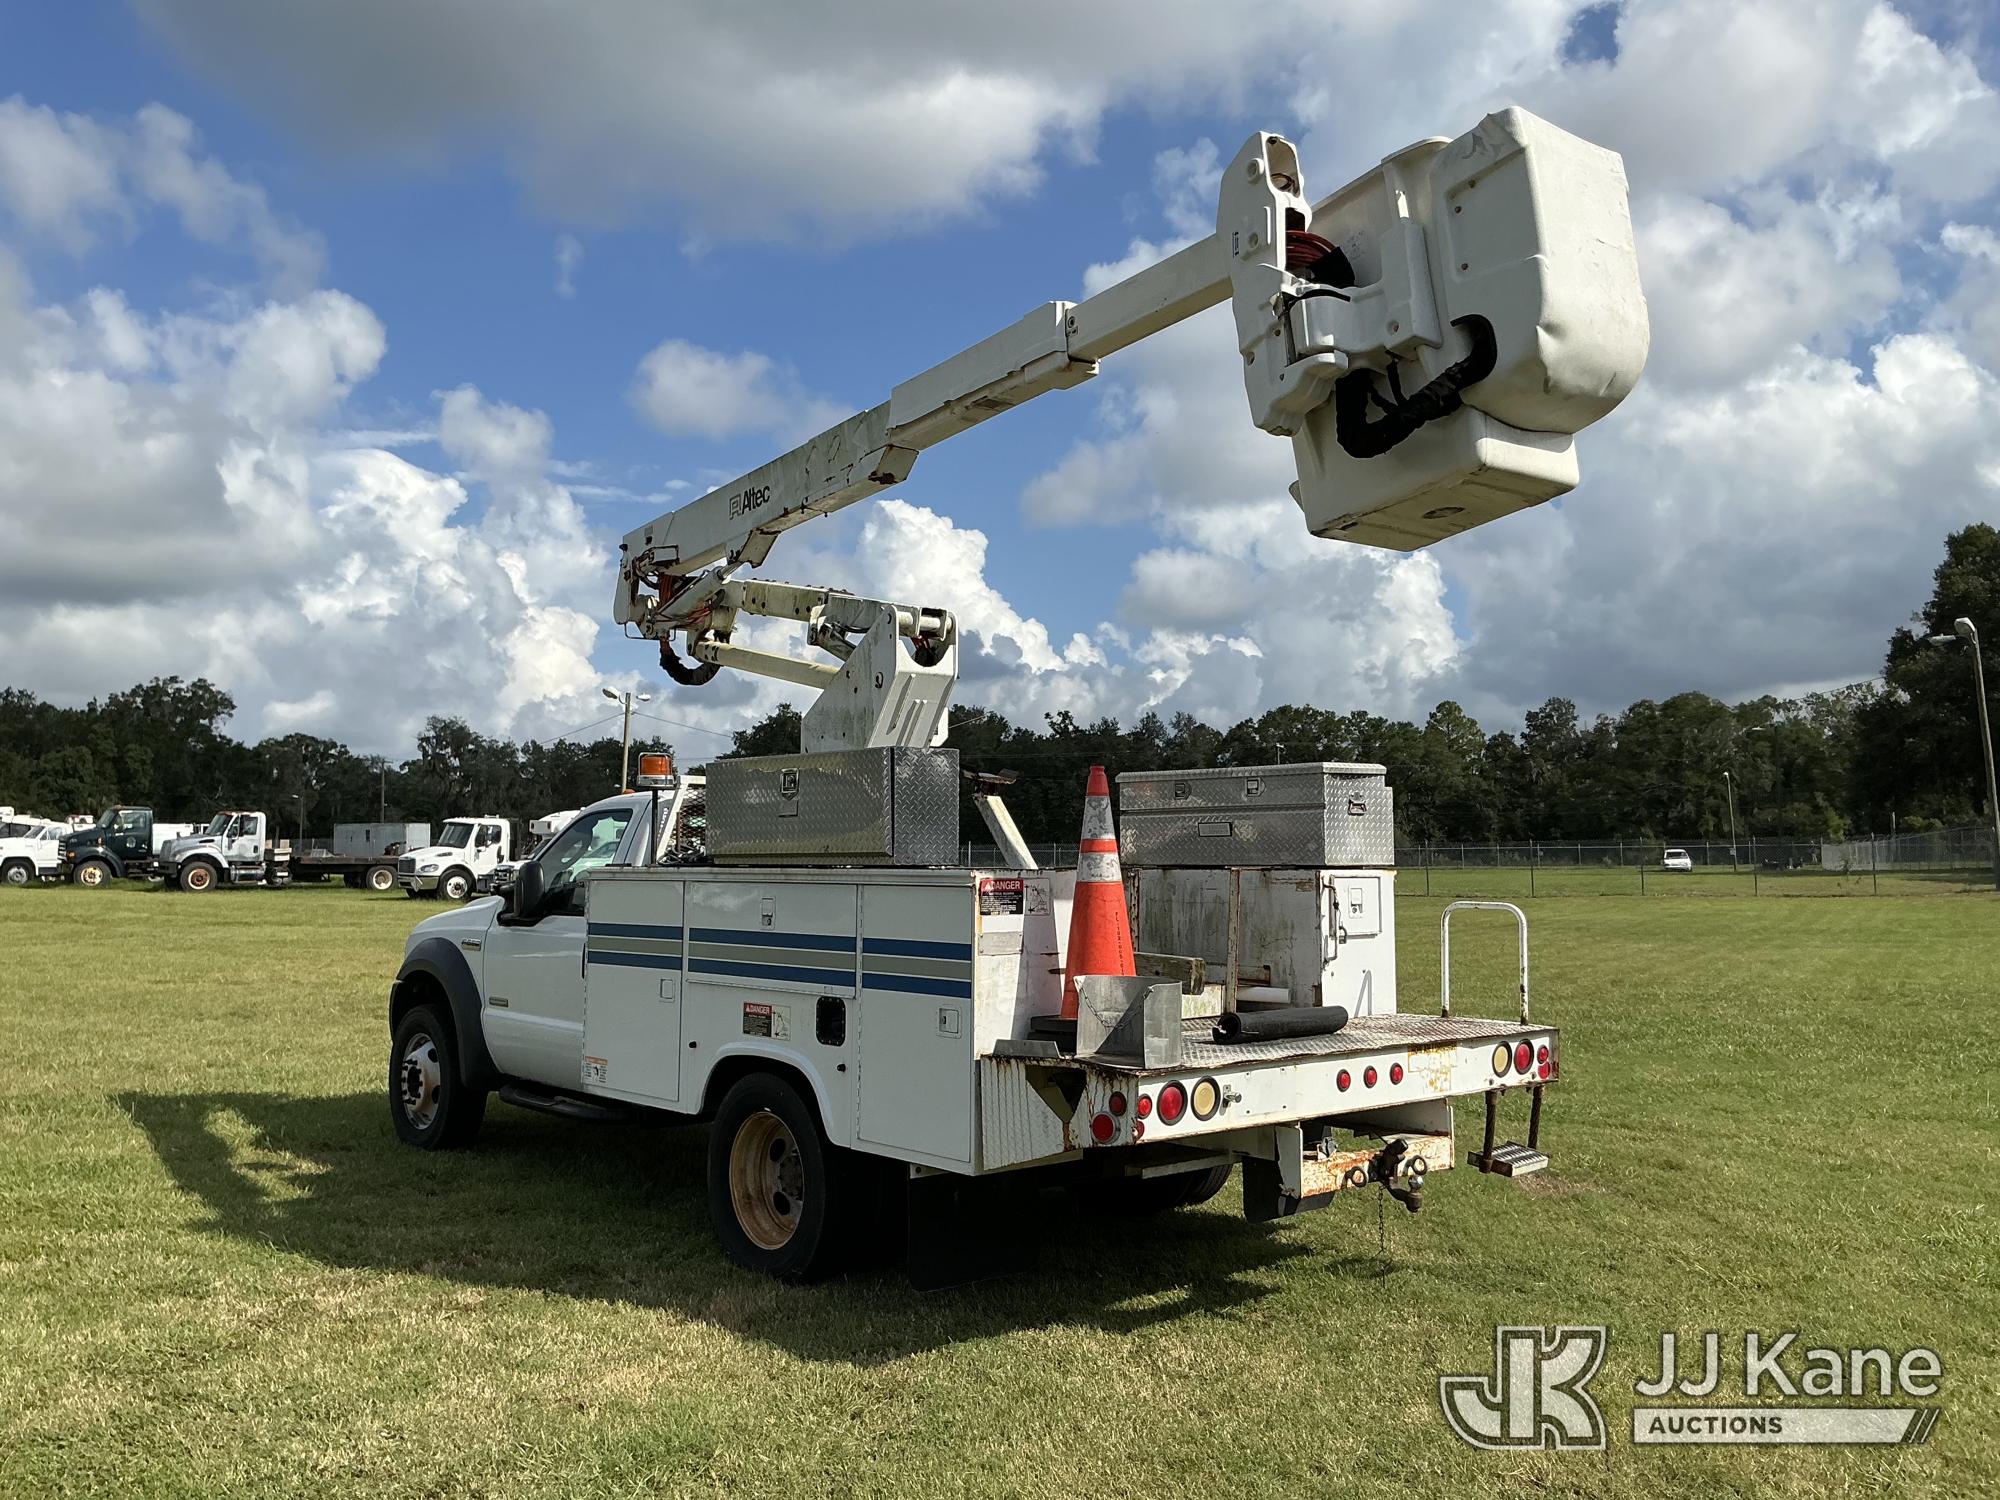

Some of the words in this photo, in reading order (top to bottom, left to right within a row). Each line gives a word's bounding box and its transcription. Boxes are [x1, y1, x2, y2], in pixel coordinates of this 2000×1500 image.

[742, 486, 770, 515] Altec
[990, 880, 1021, 890] DANGER
[750, 1005, 770, 1014] DANGER
